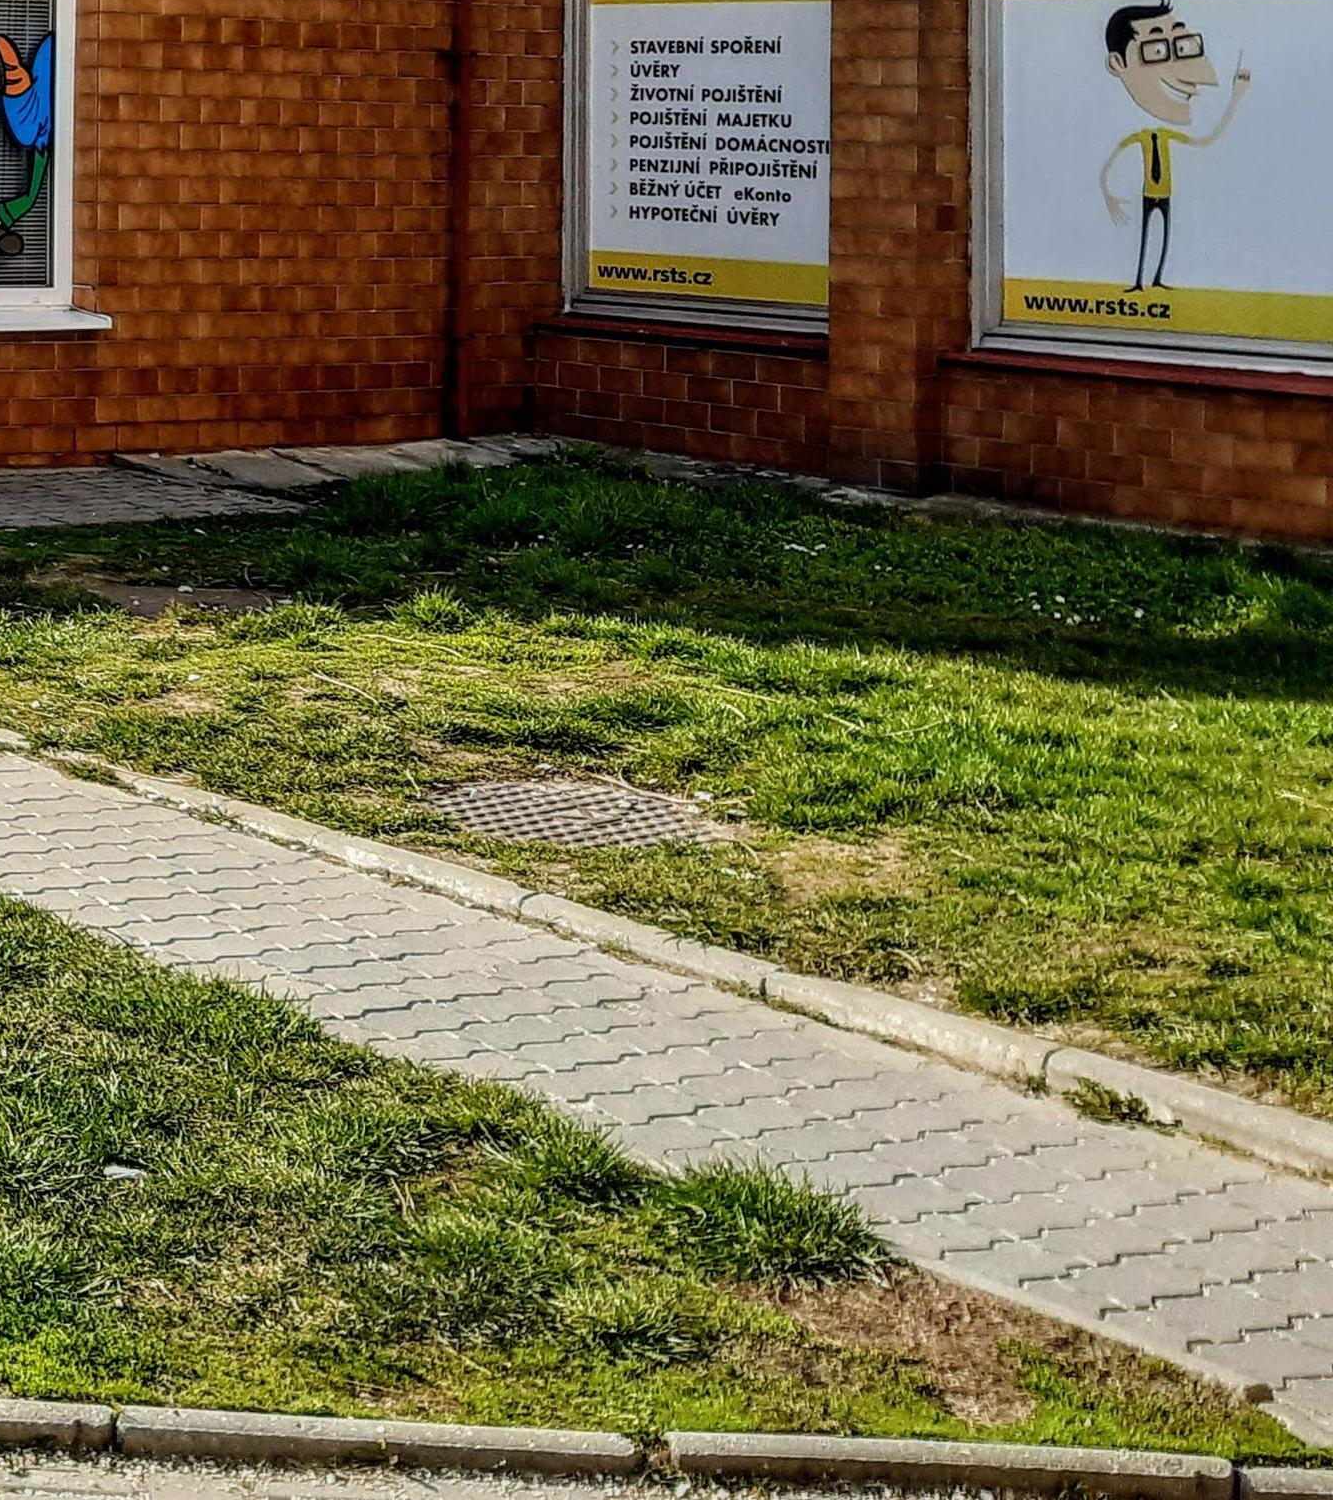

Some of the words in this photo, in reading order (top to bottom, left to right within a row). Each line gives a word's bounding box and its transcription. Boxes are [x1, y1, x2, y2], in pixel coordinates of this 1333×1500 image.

[630, 37, 704, 55] STAVEBNÍ
[710, 36, 782, 55] SPOŘENÍ
[630, 60, 681, 78] ÚVĚRY
[630, 83, 694, 102] ŽIVOTNÍ
[701, 85, 783, 104] POJIŠTĚNÍ
[629, 107, 708, 127] POJIŠTĚNÍ
[716, 112, 793, 129] MAJETKU
[629, 131, 708, 151] POJIŠTĚNÍ
[715, 134, 831, 155] DOMÁCNOSTI
[629, 156, 700, 175] PENZIJNÍ
[709, 157, 818, 180] PŘIPOJIŠTĚNÍ
[629, 178, 681, 198] BĚŽNÝ
[684, 180, 723, 200] ÚČET
[733, 186, 792, 203] eKonto
[629, 203, 718, 224] HYPOTEČNÍ
[727, 206, 781, 227] ÚVĚRY
[597, 263, 713, 287] www.rsts.cz
[1024, 292, 1172, 319] www.rsts.cz
